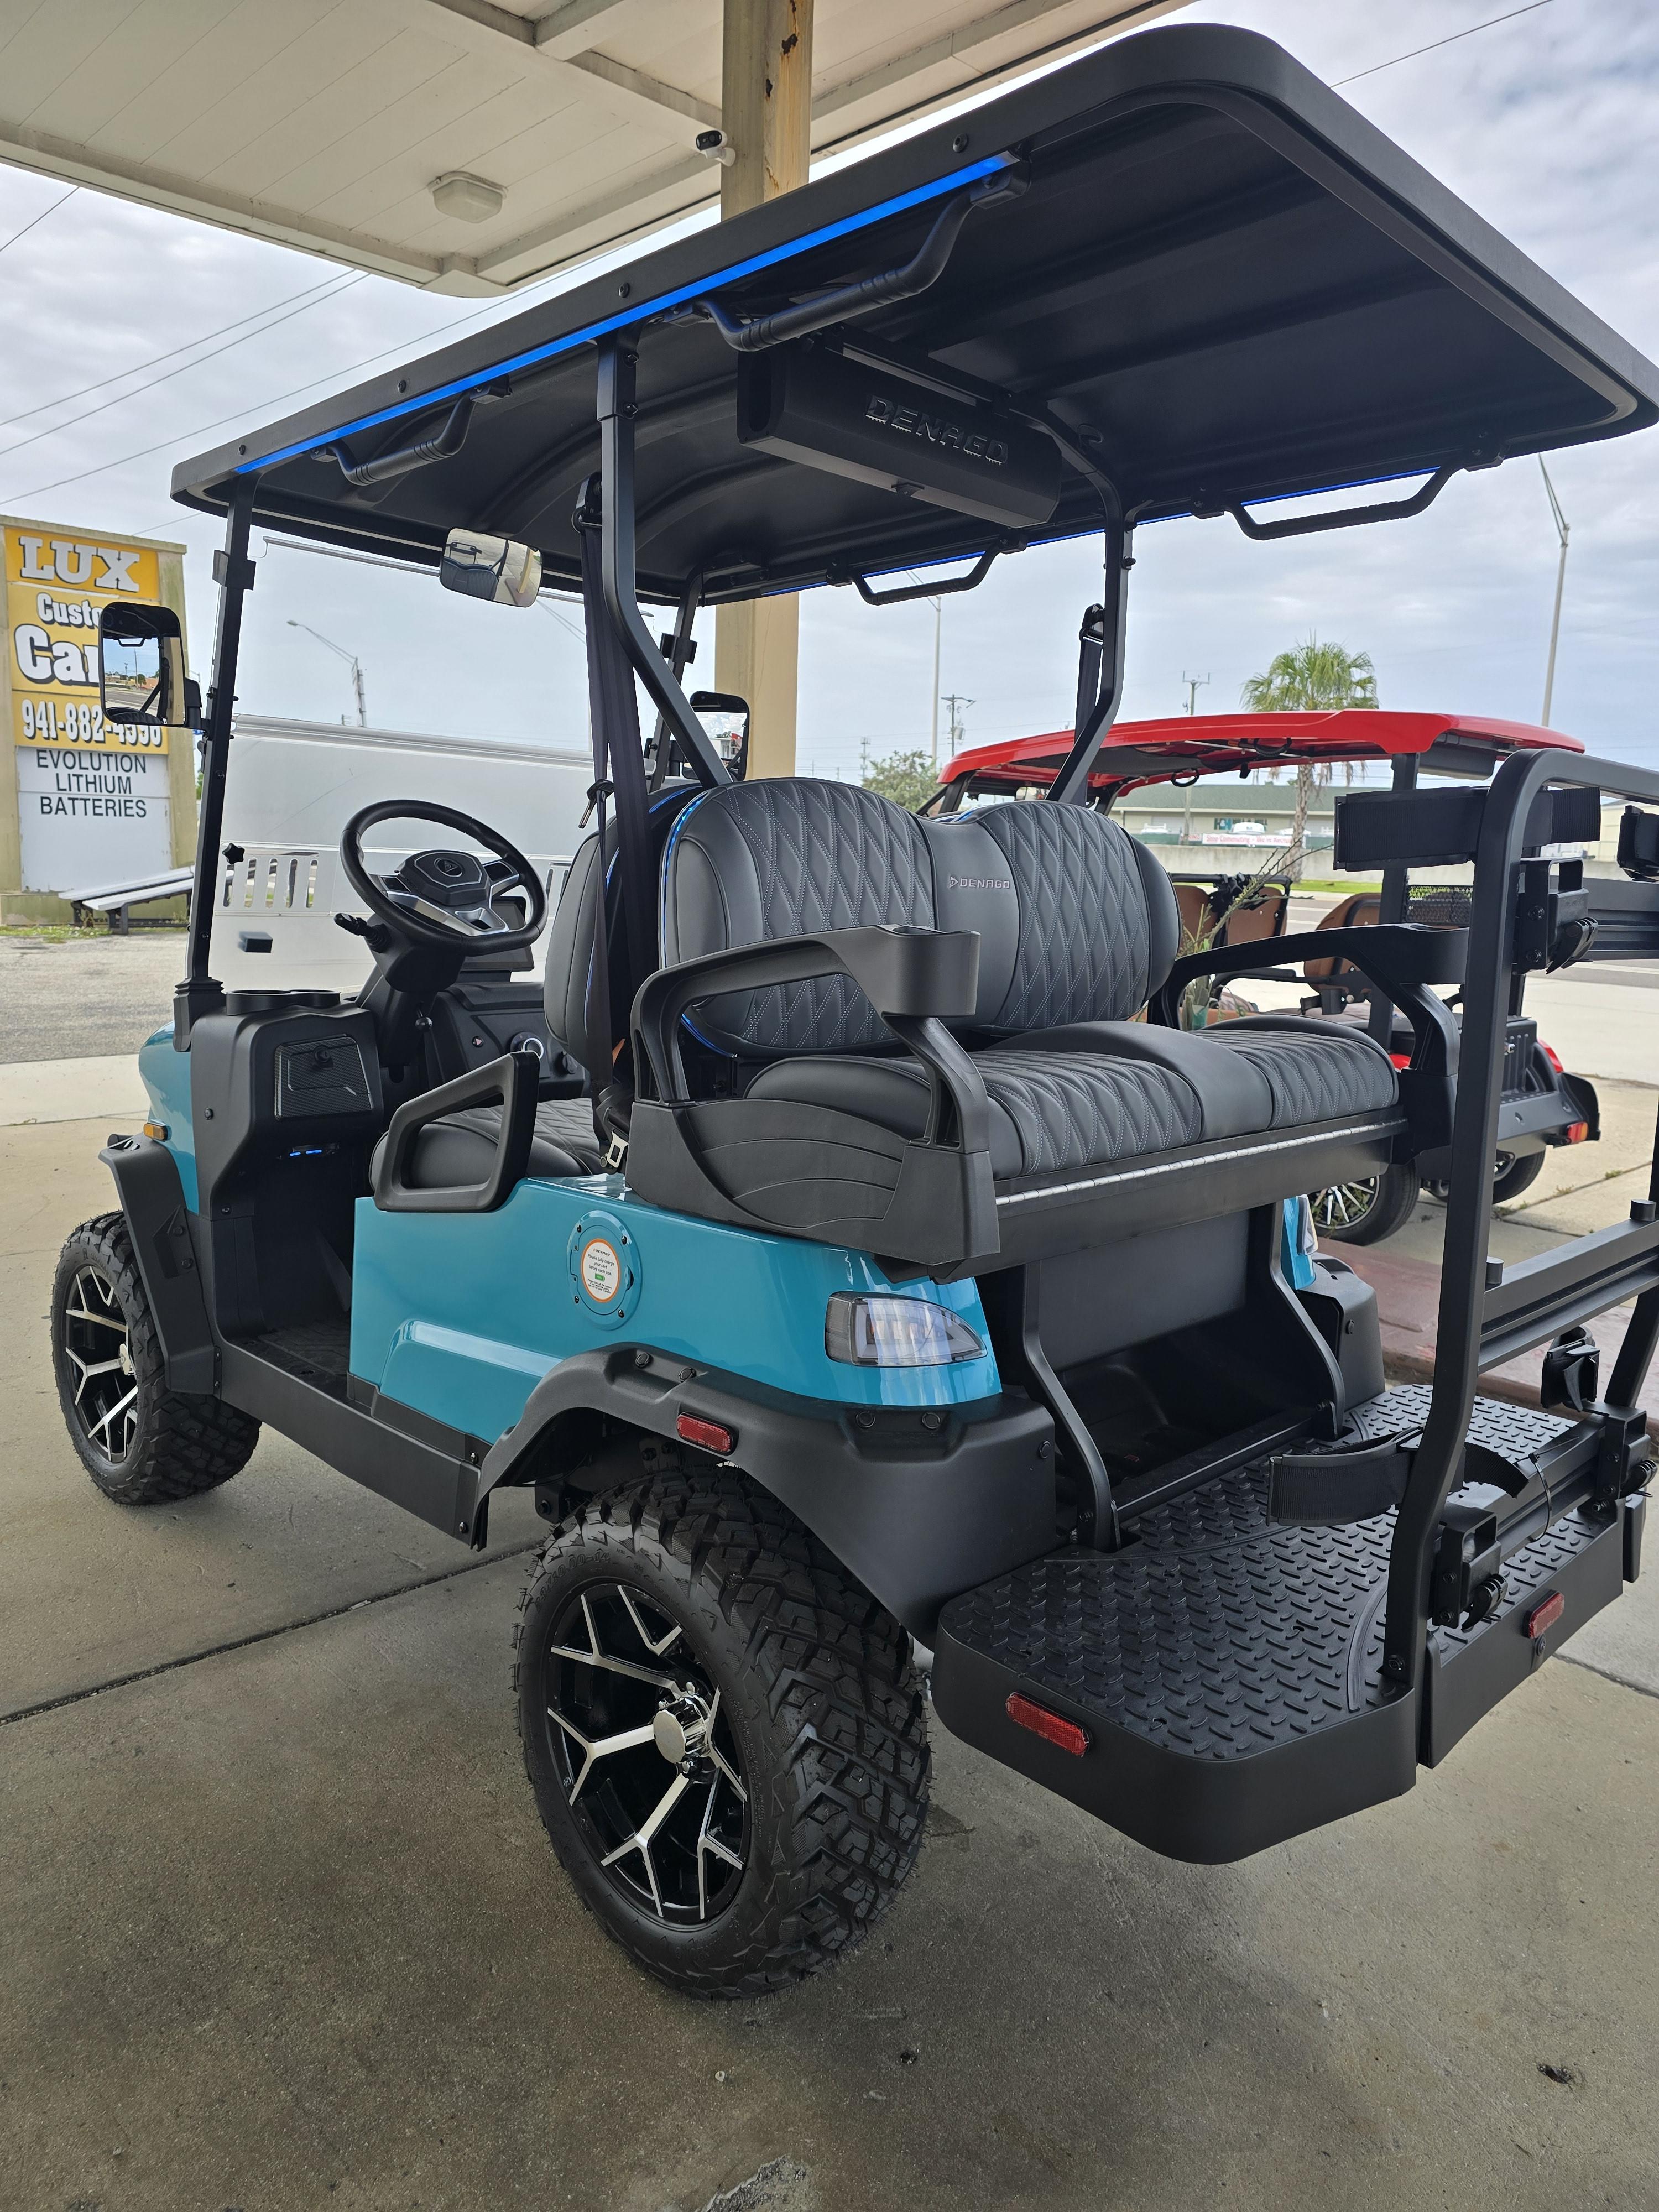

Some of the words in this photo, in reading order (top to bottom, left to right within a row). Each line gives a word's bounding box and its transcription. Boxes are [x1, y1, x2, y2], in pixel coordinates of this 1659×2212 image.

[864, 394, 1009, 466] DENAGO
[18, 535, 140, 593] LUX
[36, 592, 103, 629] Custo
[14, 623, 99, 687] Car
[36, 749, 147, 773] EVOLUTION
[55, 773, 132, 794] LITHIUM
[40, 796, 147, 818] BATTERIES
[959, 878, 1010, 889] DENAGO
